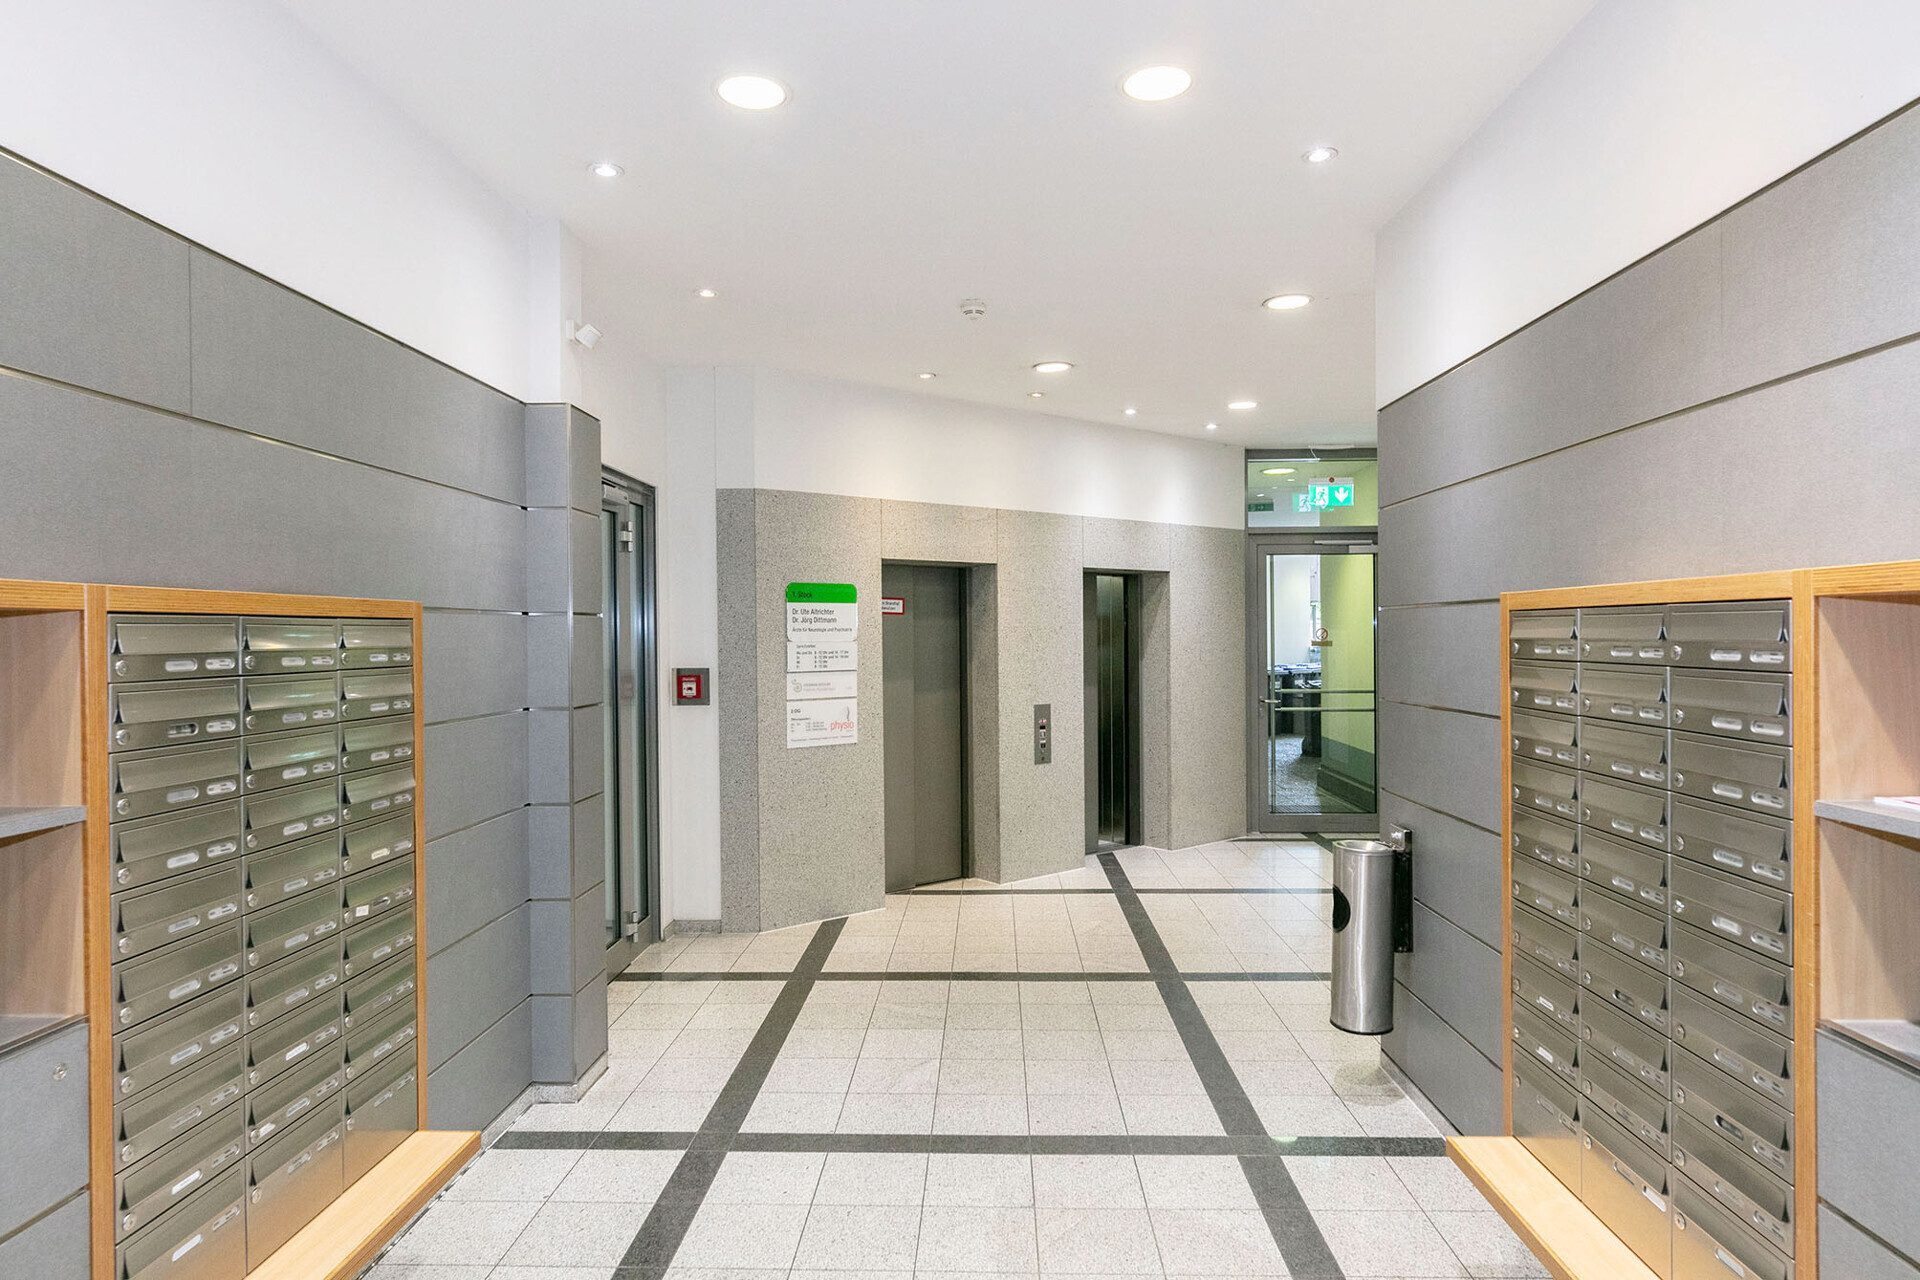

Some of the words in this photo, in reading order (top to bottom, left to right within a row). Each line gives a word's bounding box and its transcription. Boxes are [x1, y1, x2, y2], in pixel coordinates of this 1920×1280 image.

[800, 616, 813, 625] Jörg
[813, 616, 837, 624] Dittmann
[830, 720, 855, 732] physio
